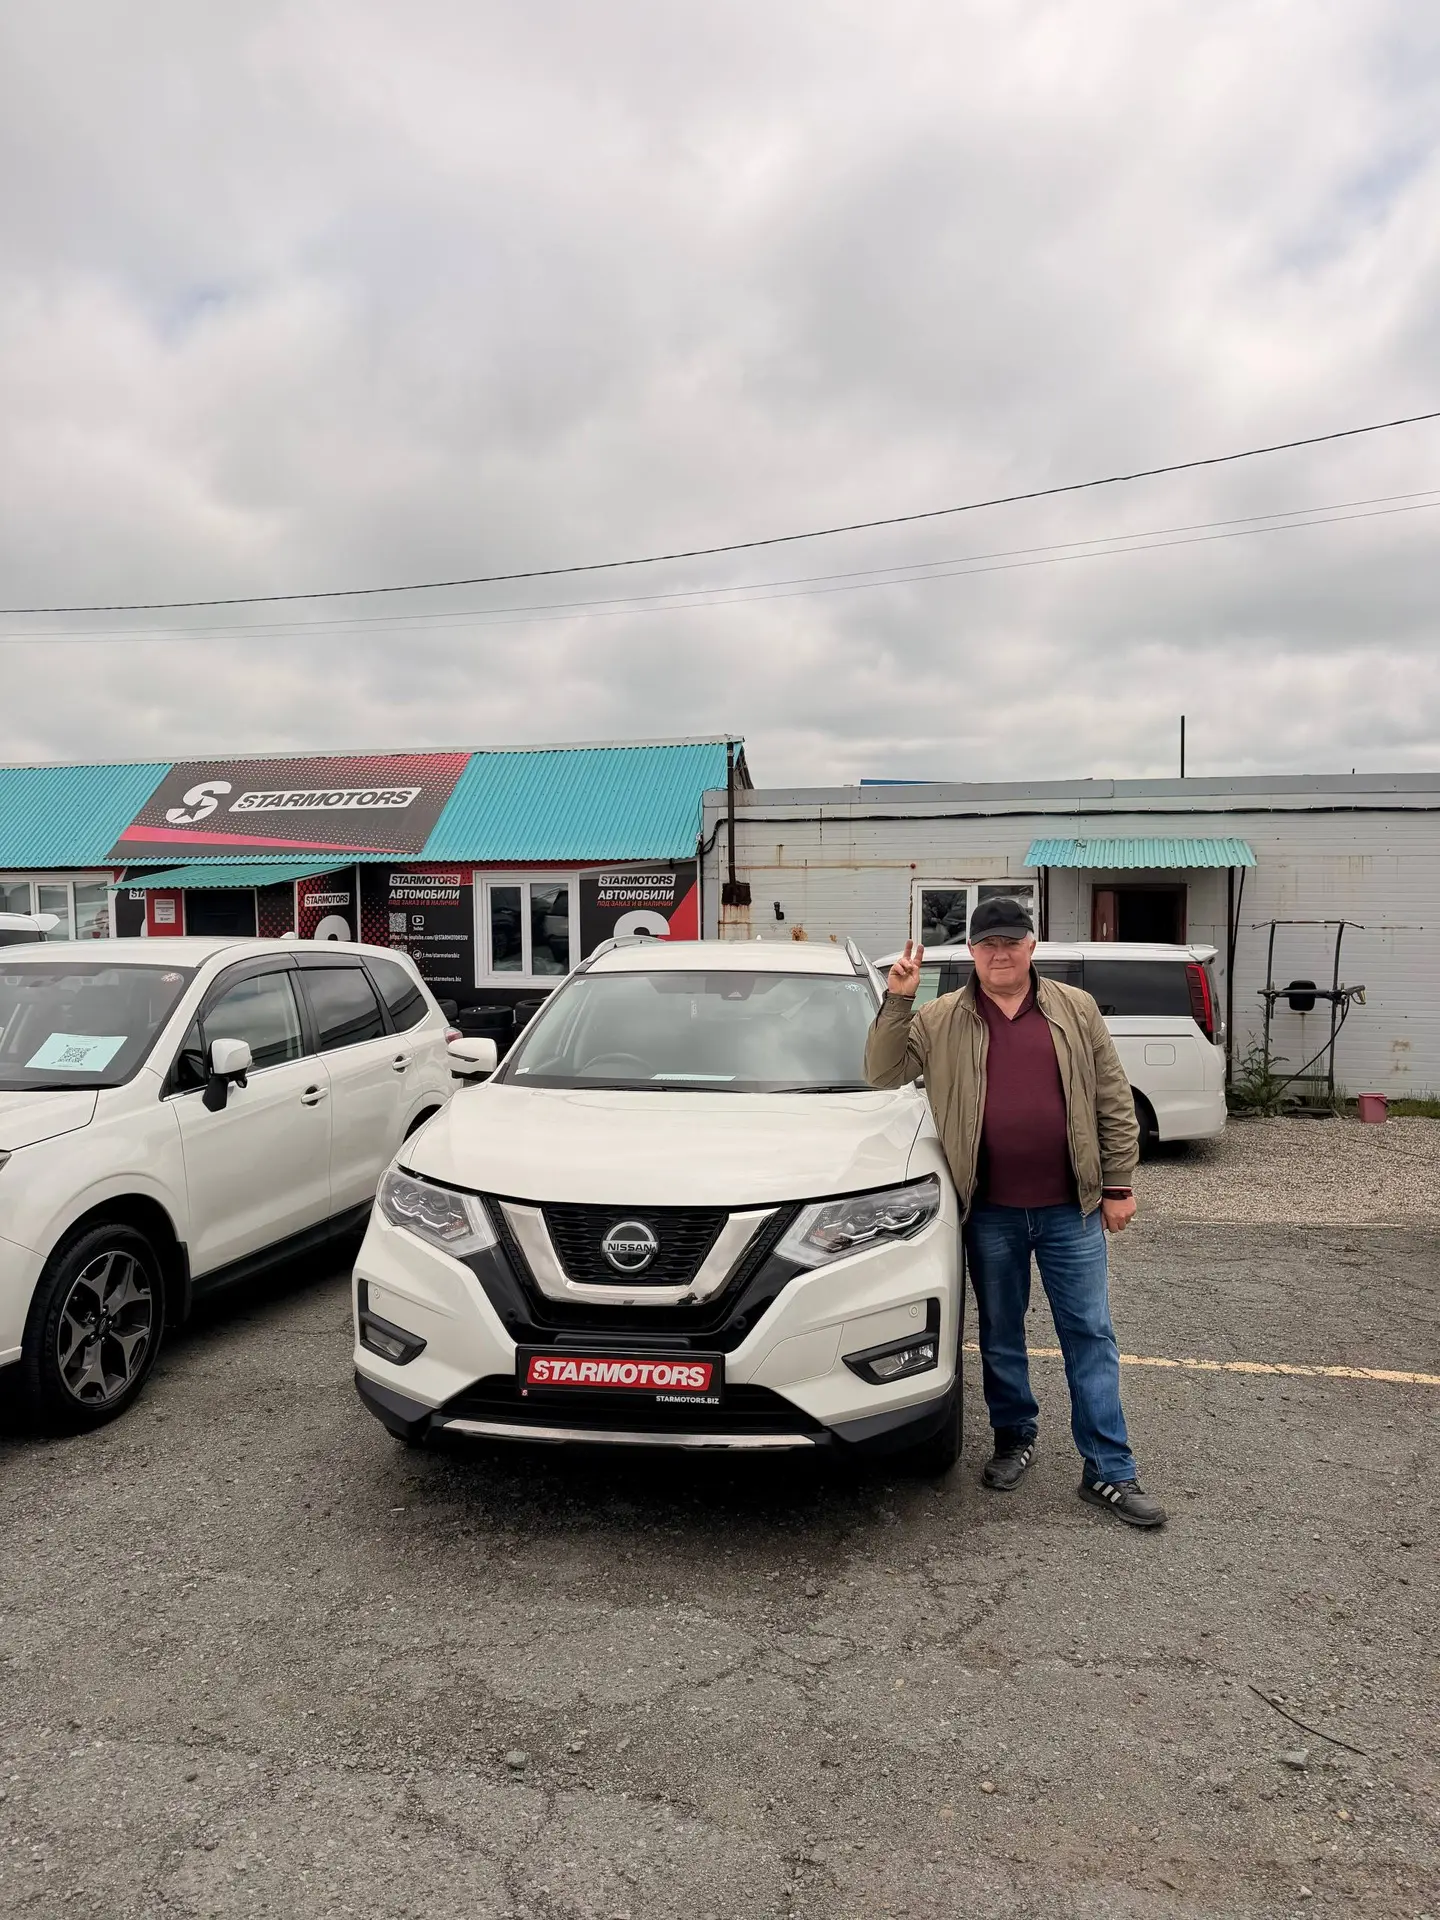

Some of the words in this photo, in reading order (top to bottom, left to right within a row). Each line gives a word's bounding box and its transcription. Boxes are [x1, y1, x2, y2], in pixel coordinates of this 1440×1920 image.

[237, 789, 413, 809] STARMOTORS
[391, 875, 459, 885] STARMOTORS
[600, 875, 674, 885] STARMOTORS
[388, 889, 460, 899] АВТОМОБИЛИ
[597, 889, 675, 900] АВТОМОБИЛИ
[305, 894, 349, 905] STARMOTORS
[607, 1243, 652, 1252] NISSAN
[532, 1360, 705, 1387] STARMOTORS
[656, 1395, 720, 1405] STARMOTORS.BIZ
